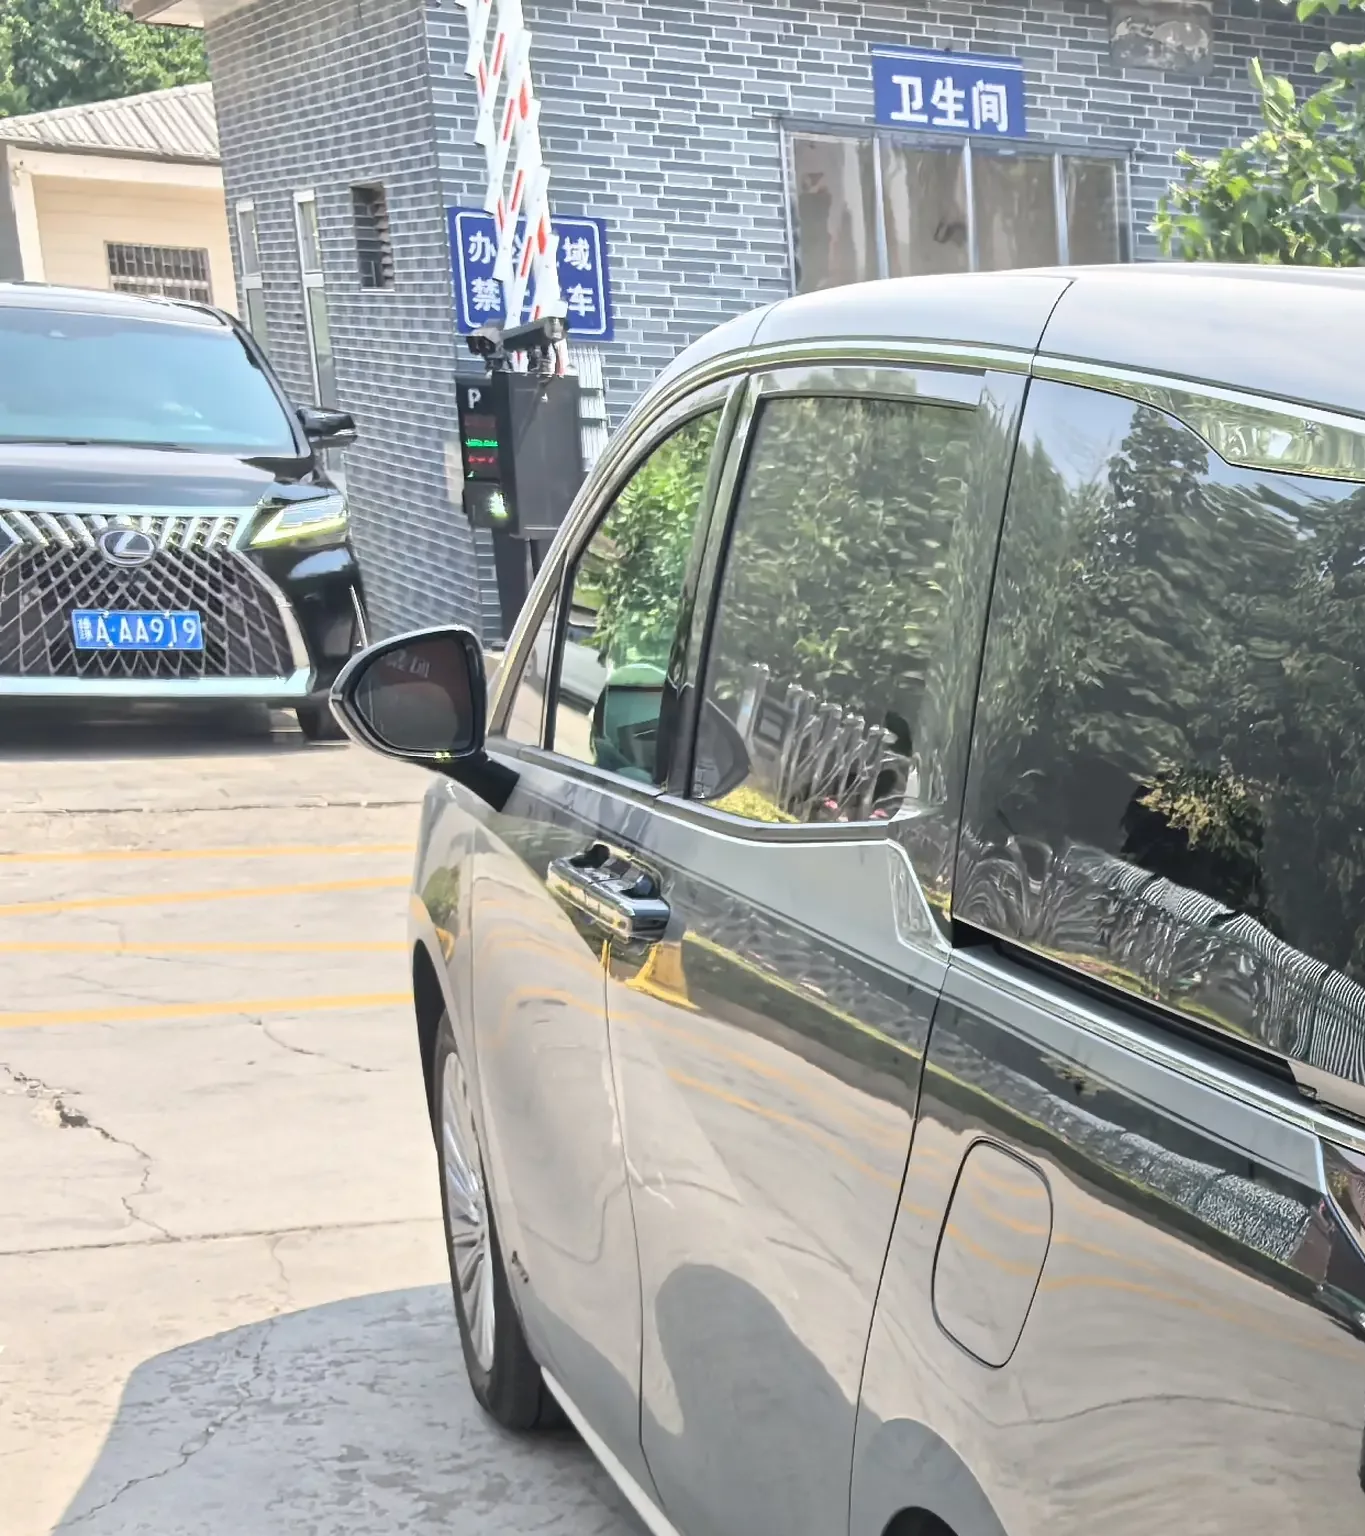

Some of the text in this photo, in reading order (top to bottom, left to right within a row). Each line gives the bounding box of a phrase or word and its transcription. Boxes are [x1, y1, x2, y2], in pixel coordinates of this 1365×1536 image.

[890, 74, 1009, 132] 卫生间
[468, 230, 592, 271] 办域
[471, 277, 596, 317] 禁车
[467, 388, 481, 409] P
